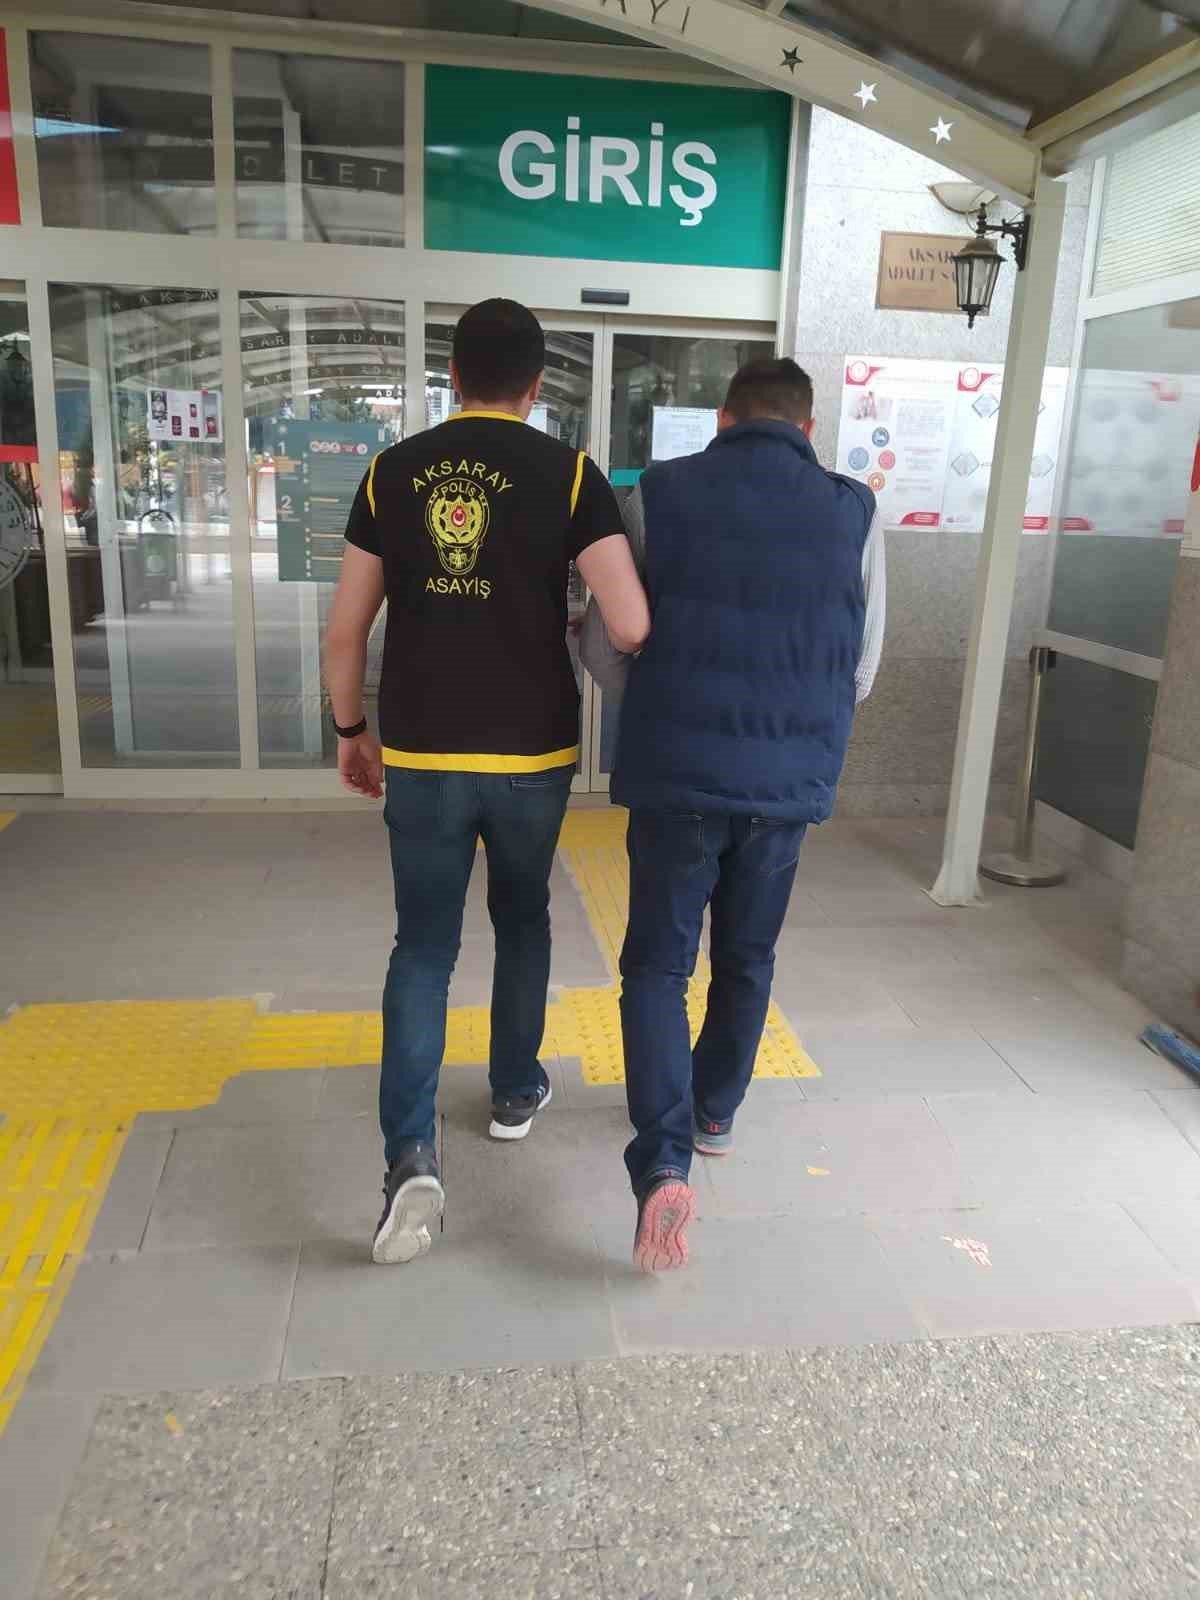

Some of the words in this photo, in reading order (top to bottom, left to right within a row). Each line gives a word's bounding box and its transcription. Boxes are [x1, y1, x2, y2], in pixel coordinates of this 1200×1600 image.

[498, 116, 718, 227] GİRİŞ
[904, 247, 962, 263] AKSAR
[411, 458, 514, 493] AKSARAY
[440, 480, 477, 498] POLİS
[424, 576, 492, 600] ASAYİŞ
